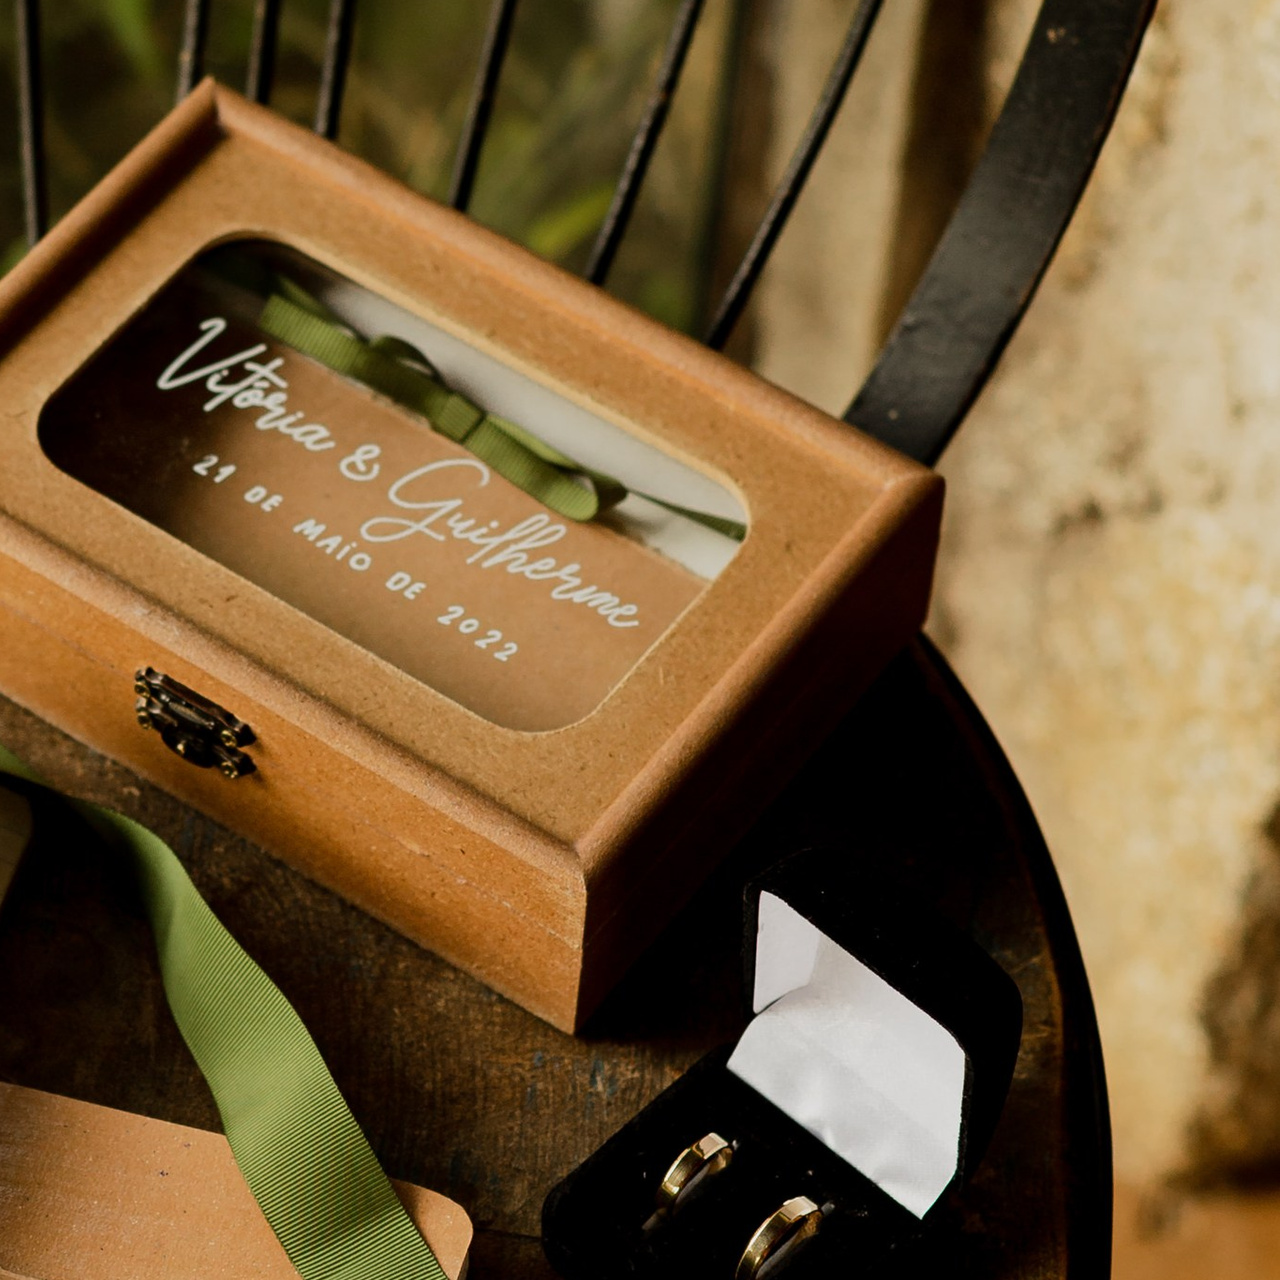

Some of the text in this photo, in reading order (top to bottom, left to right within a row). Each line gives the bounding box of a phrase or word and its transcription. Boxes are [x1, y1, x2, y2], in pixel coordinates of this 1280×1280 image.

[157, 317, 639, 628] Vitória & Guilherme
[192, 454, 237, 483] 21
[243, 485, 283, 512] DE
[386, 572, 426, 600] DE
[437, 606, 518, 662] 2022
